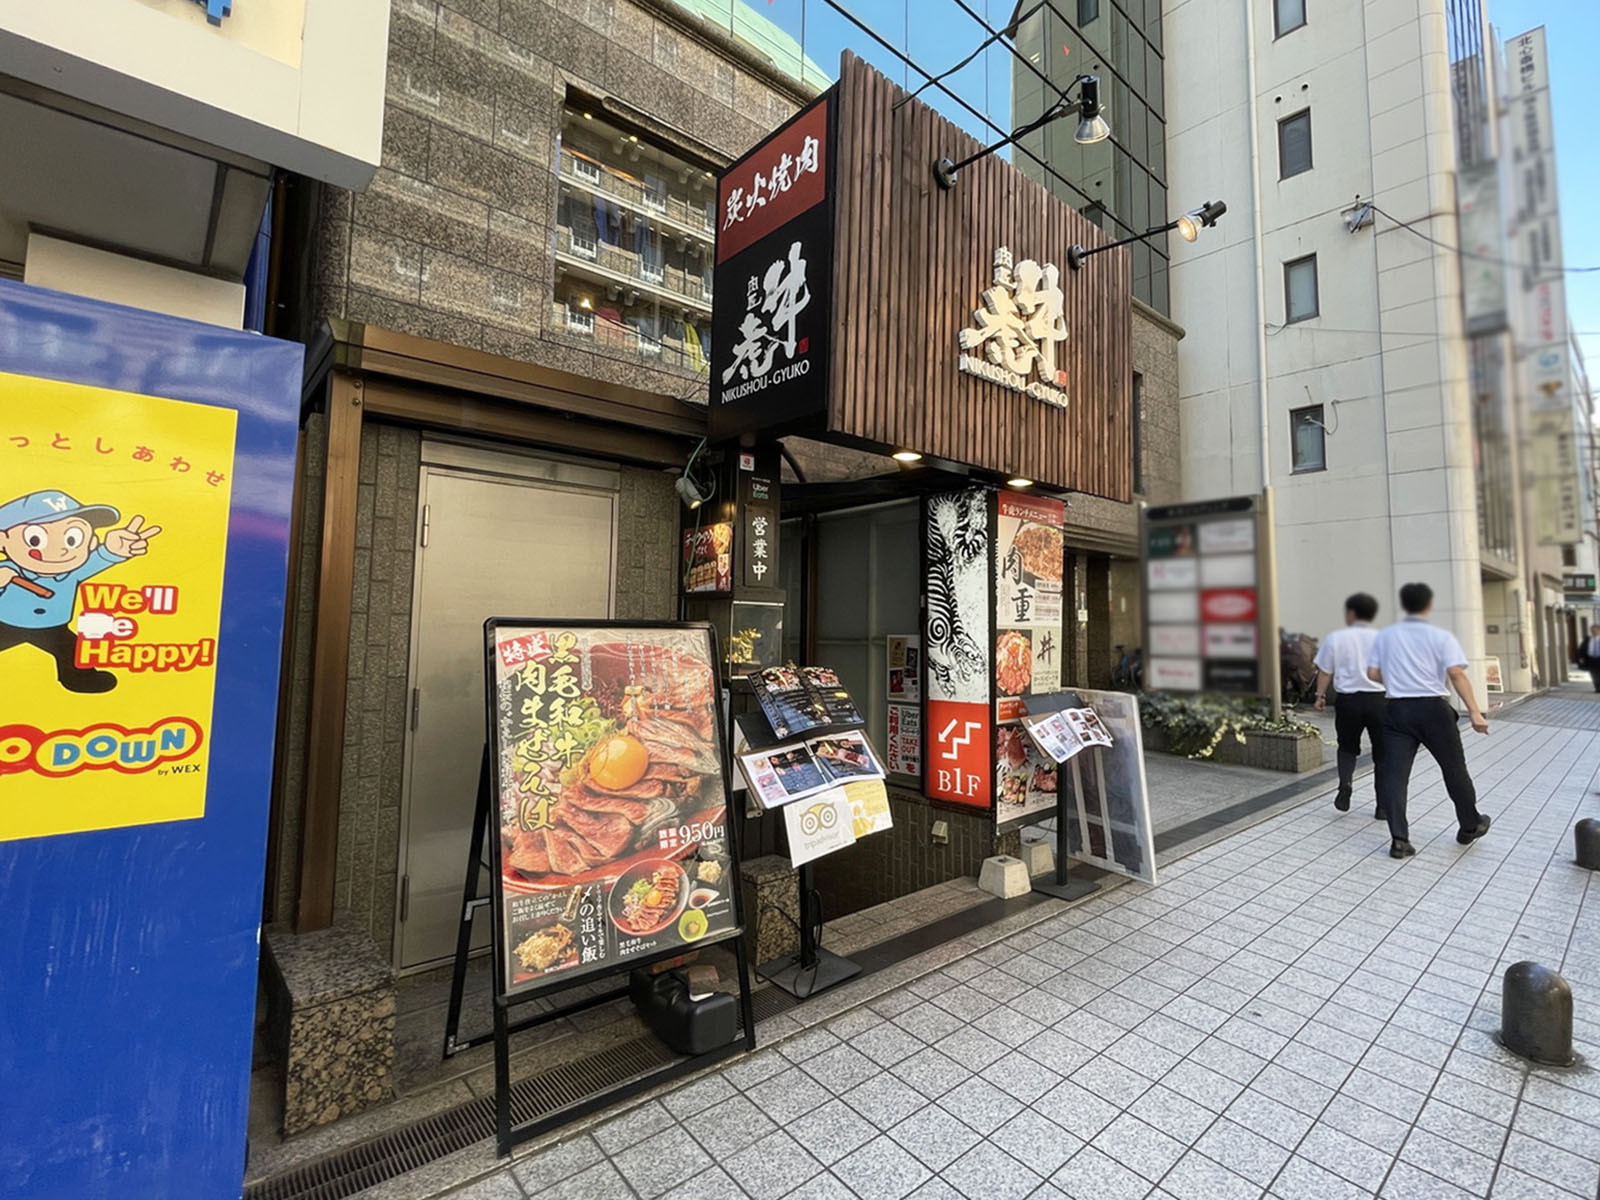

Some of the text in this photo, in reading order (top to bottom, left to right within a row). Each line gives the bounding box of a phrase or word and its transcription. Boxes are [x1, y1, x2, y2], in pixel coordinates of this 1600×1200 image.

[723, 136, 819, 231] 炭火焼肉
[8, 433, 226, 488] っとしあわせ
[752, 516, 768, 581] 営業中
[84, 585, 175, 611] We'll
[1001, 547, 1034, 623] 肉重
[78, 640, 212, 670] Happy!
[548, 632, 585, 768] 黒毛和牛
[52, 728, 187, 767] DOWN
[171, 763, 201, 775] WEX
[937, 768, 982, 797] B1F
[678, 820, 725, 847] 950円
[579, 886, 598, 964] 〆の追い飯
